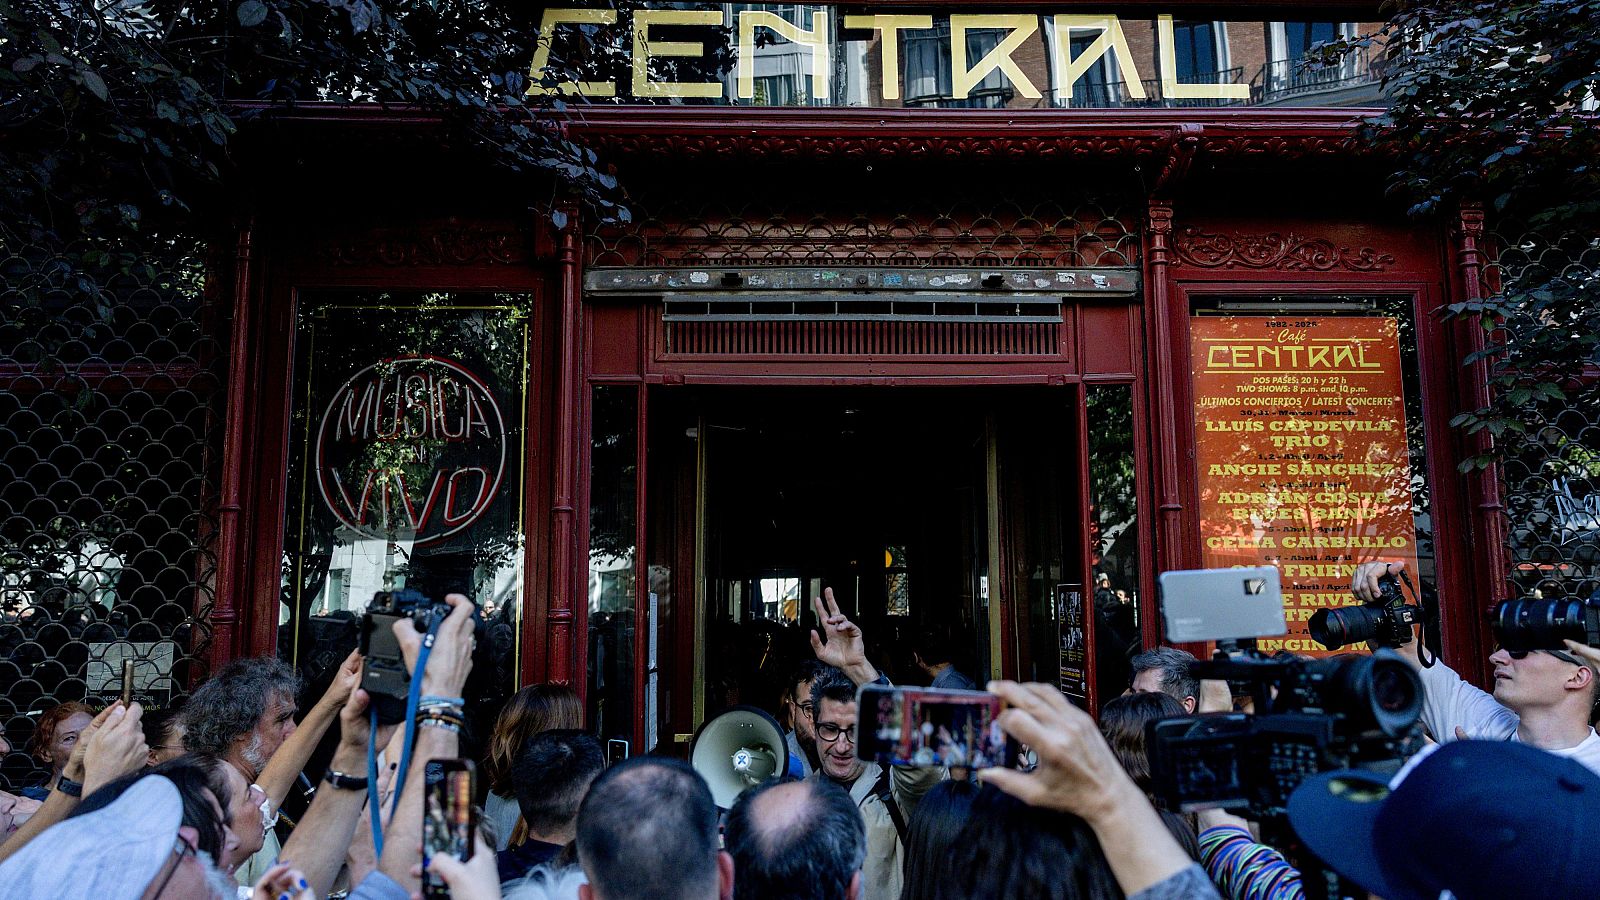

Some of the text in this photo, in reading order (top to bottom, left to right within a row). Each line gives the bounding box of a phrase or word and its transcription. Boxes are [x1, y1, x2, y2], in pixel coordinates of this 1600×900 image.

[524, 8, 1250, 99] CENTRAL
[1277, 328, 1307, 344] Café
[1207, 345, 1381, 368] CENTRAL
[1253, 376, 1270, 384] DOS
[1272, 376, 1299, 384] PASES:
[1301, 376, 1312, 384] 20
[1313, 376, 1319, 384] h
[1328, 376, 1339, 384] 22
[1341, 376, 1347, 384] h
[1236, 385, 1256, 393] TWO
[1258, 385, 1291, 393] SHOWS:
[1293, 385, 1298, 393] 8
[1300, 386, 1318, 394] p.m.
[1320, 385, 1336, 393] and
[1349, 386, 1368, 394] p.m.
[1243, 397, 1302, 406] CONCIERTOS
[1312, 397, 1343, 406] LATEST
[1345, 397, 1393, 406] CONCERTS
[1205, 418, 1392, 432] LLUÍS CAPDEVILA
[1270, 435, 1330, 447] TRIO
[1208, 464, 1281, 476] ANGIE
[1315, 492, 1390, 504] COSTA
[1311, 508, 1377, 520] BAND
[1281, 536, 1407, 548] CARBALLO
[1283, 564, 1357, 577] FRIEN
[1300, 593, 1363, 606] RIVE
